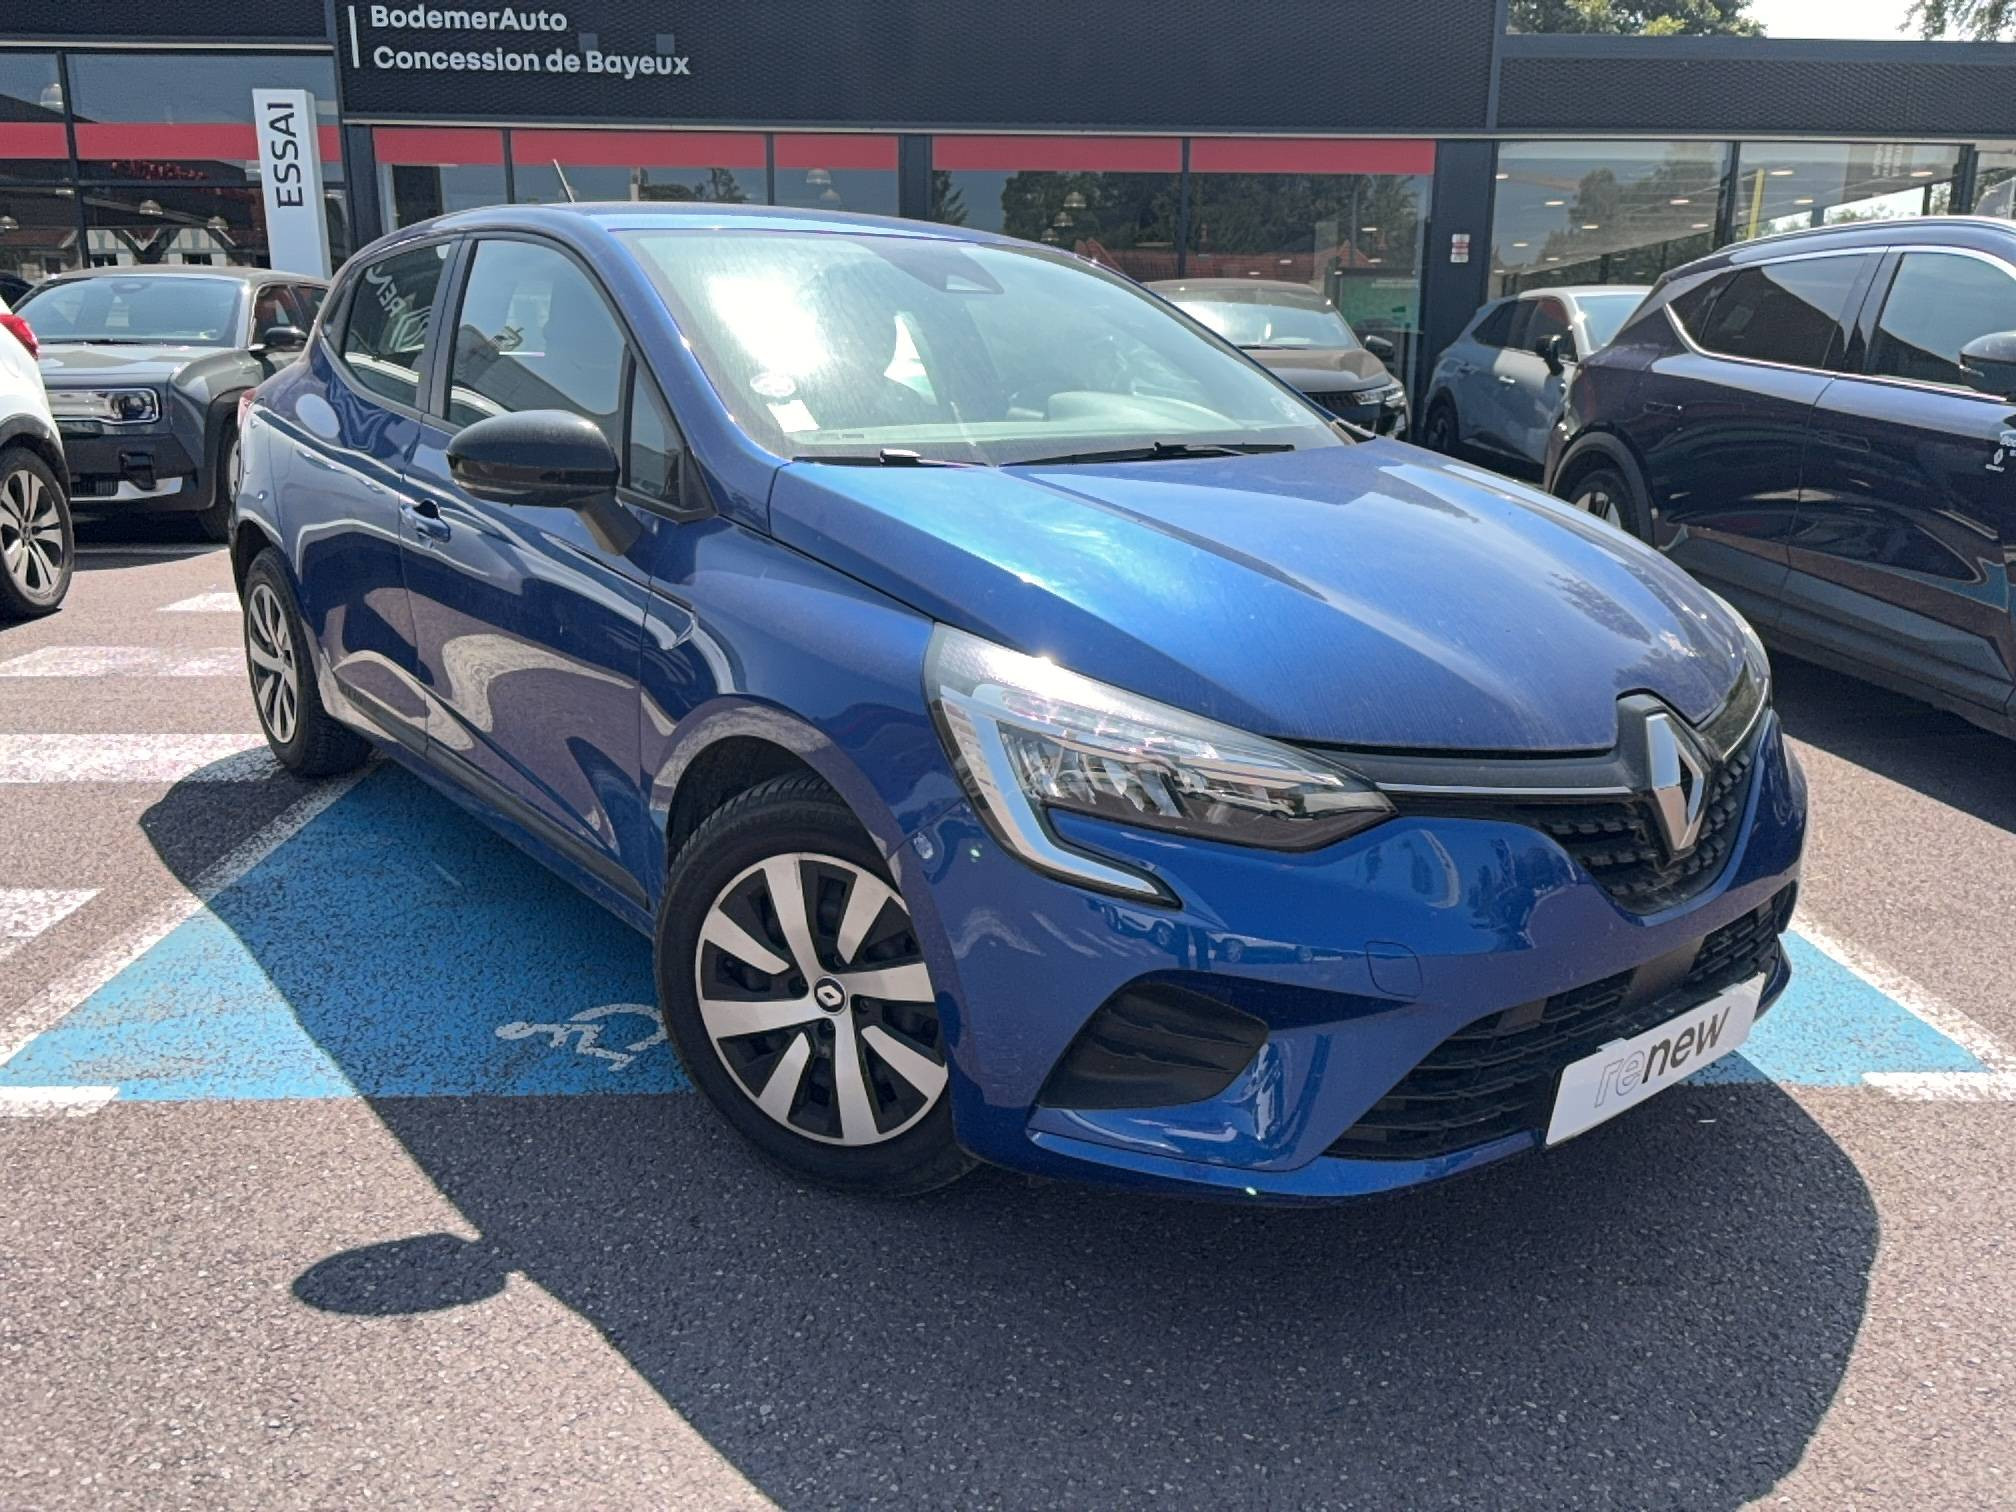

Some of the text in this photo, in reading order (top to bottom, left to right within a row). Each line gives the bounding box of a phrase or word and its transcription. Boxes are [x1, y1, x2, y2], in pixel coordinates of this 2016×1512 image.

[371, 4, 568, 32] BodemerAuto
[373, 46, 691, 80] Concession de Bayeux
[267, 102, 304, 208] ESSAI
[1594, 1006, 1732, 1109] renew
